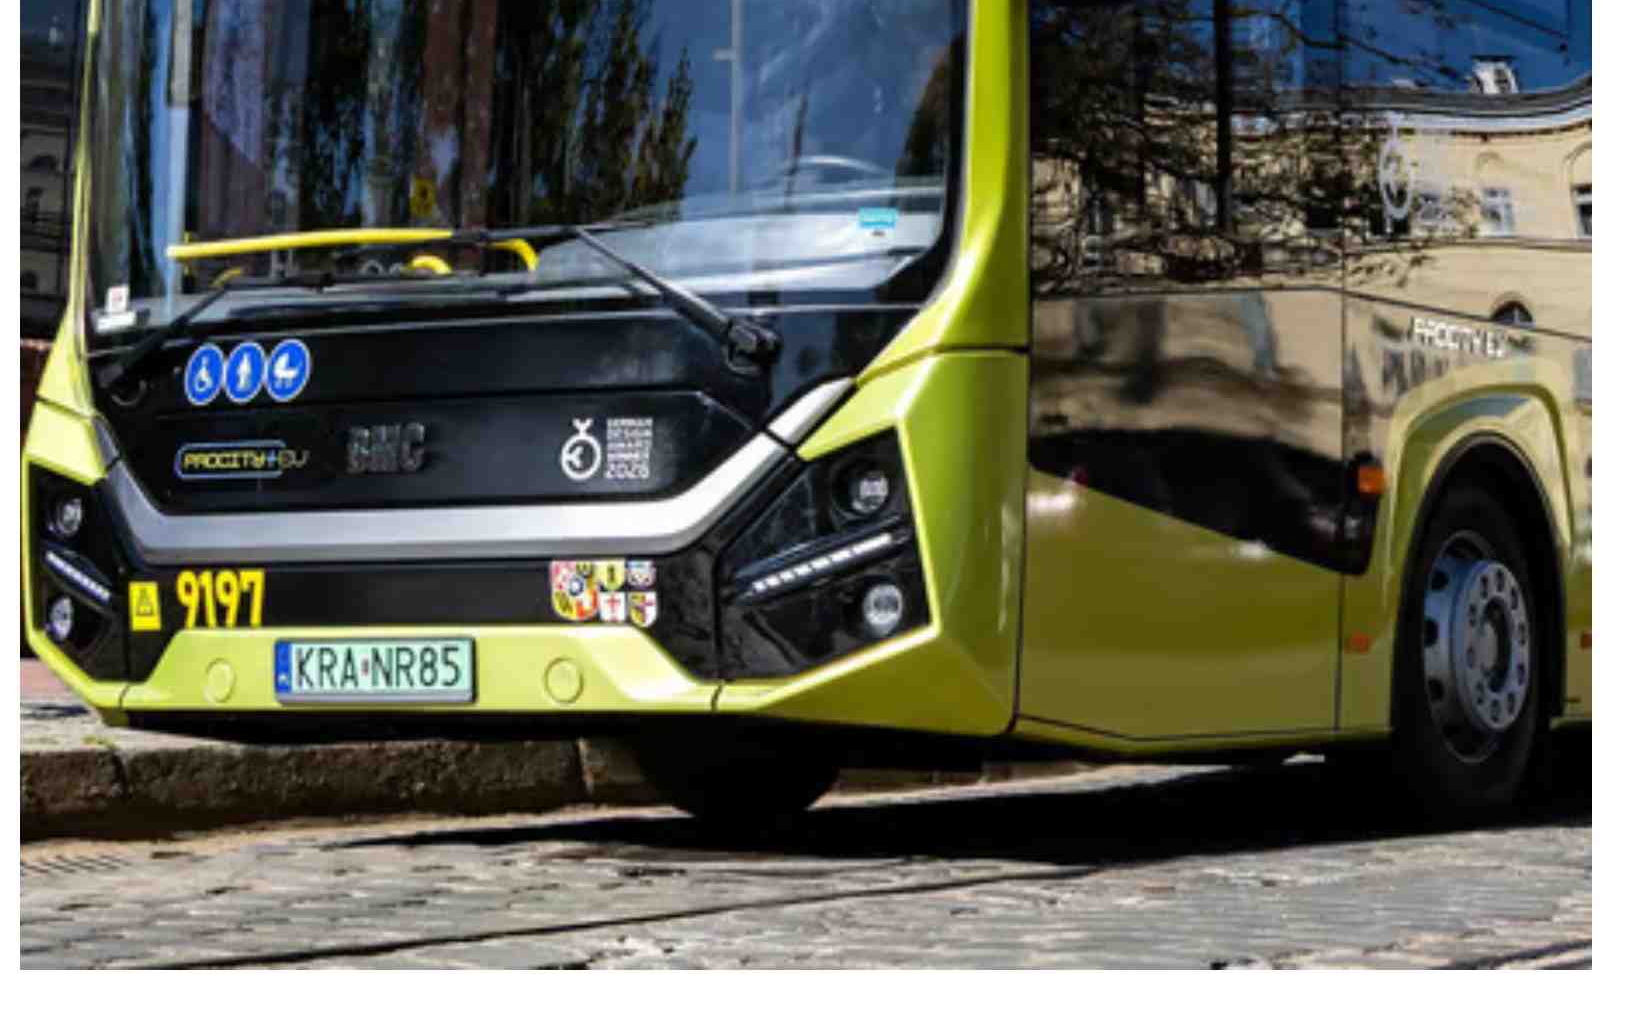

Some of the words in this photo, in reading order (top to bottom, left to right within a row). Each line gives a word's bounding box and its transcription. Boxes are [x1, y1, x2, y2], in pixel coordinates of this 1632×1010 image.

[176, 569, 264, 629] 9197
[296, 647, 359, 688] KRA
[371, 646, 462, 688] NR85
